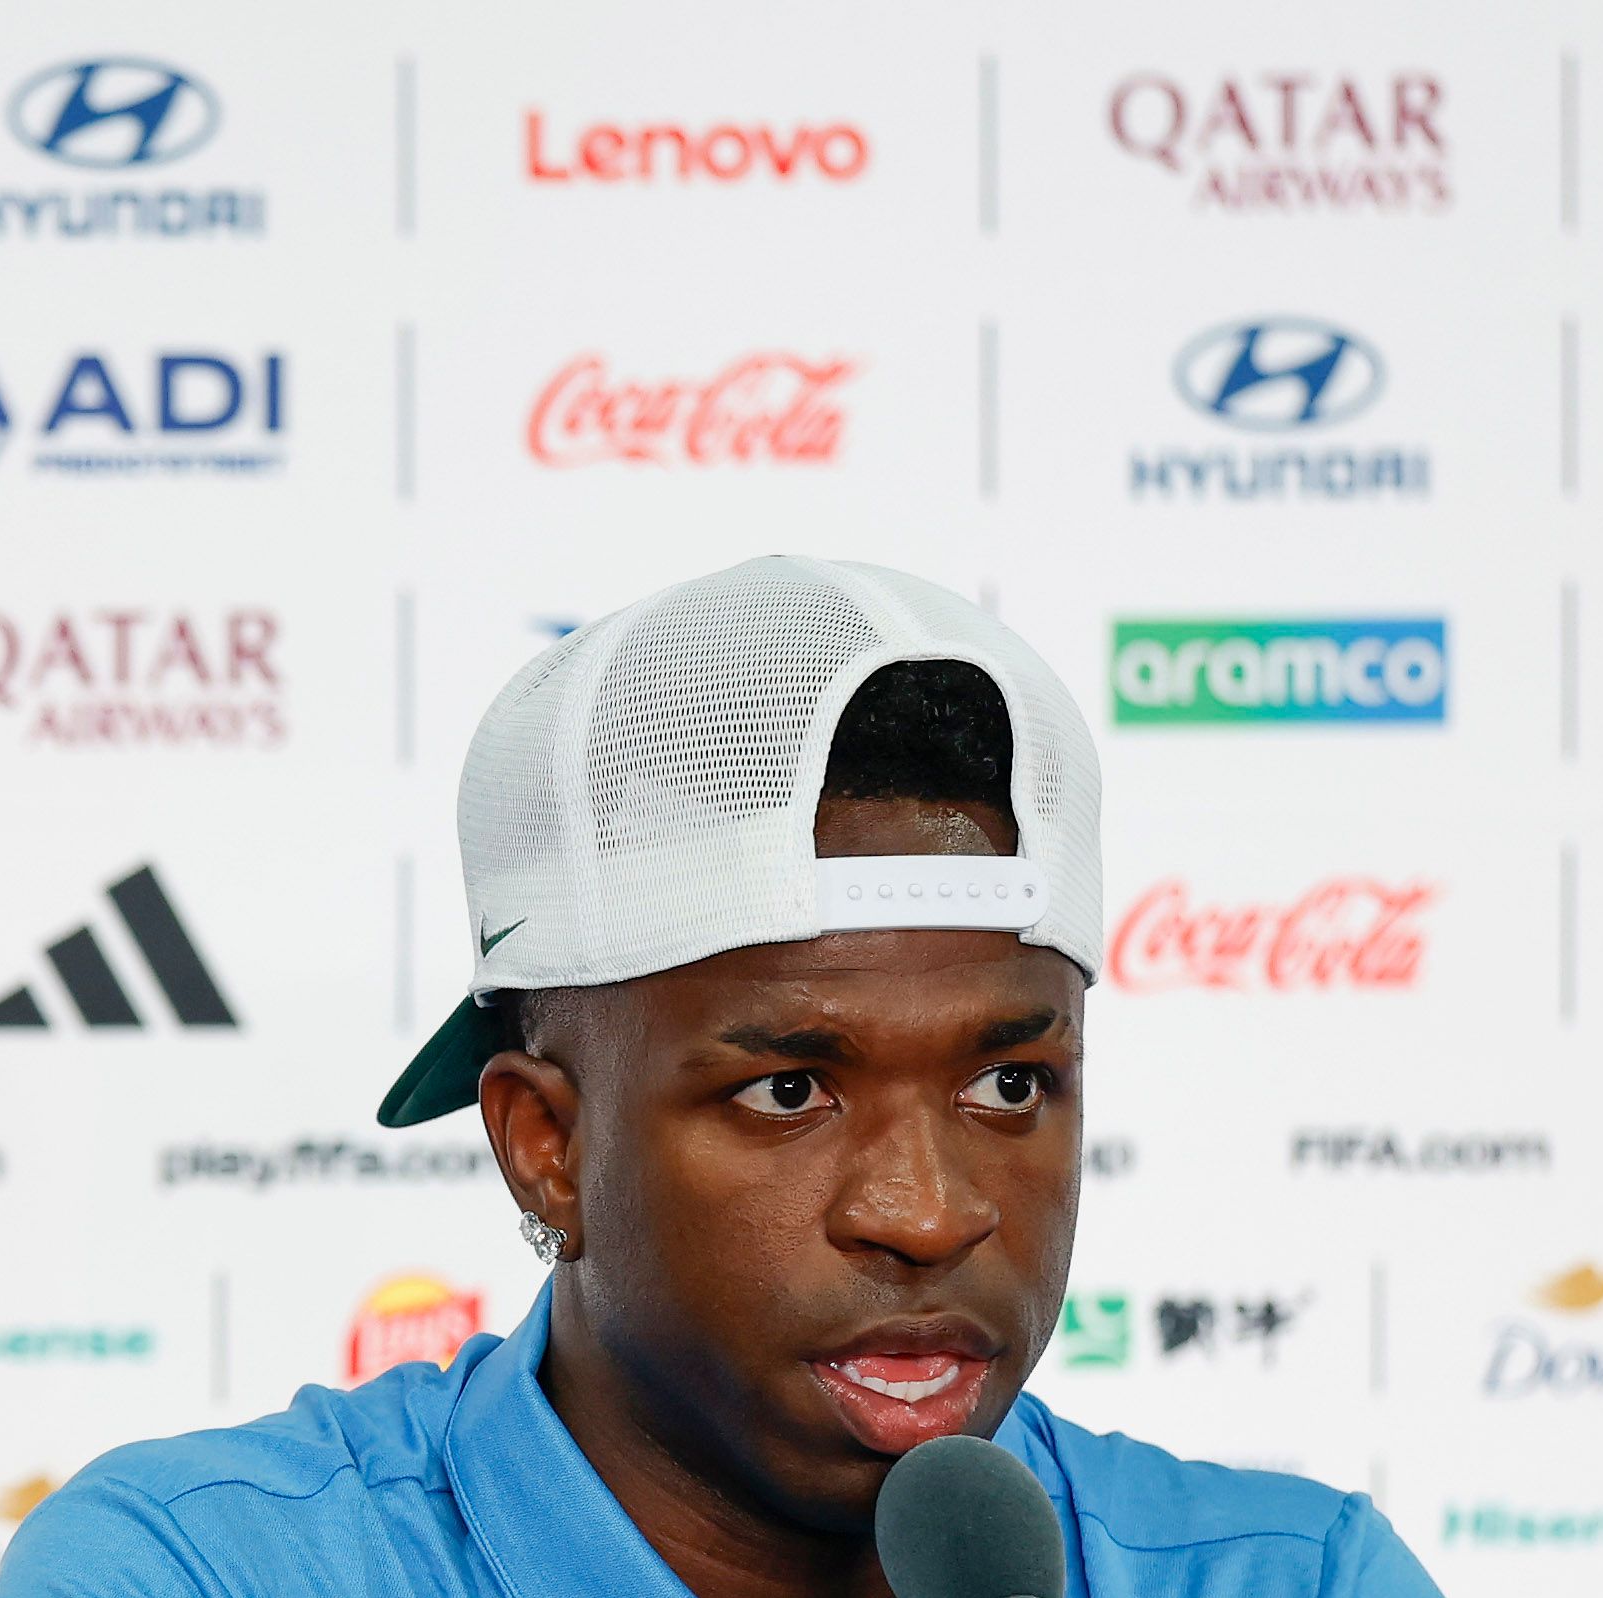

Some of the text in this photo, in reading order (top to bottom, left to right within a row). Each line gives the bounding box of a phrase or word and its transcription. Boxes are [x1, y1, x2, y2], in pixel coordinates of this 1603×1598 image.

[525, 111, 869, 183] Lenovo
[1107, 75, 1445, 176] QATAR
[1201, 174, 1451, 210] AIRWAYS
[41, 352, 284, 436] ADI
[1130, 448, 1430, 500] HYUNDAI
[1119, 640, 1442, 705] aramco
[31, 697, 286, 747] AIRWAYS
